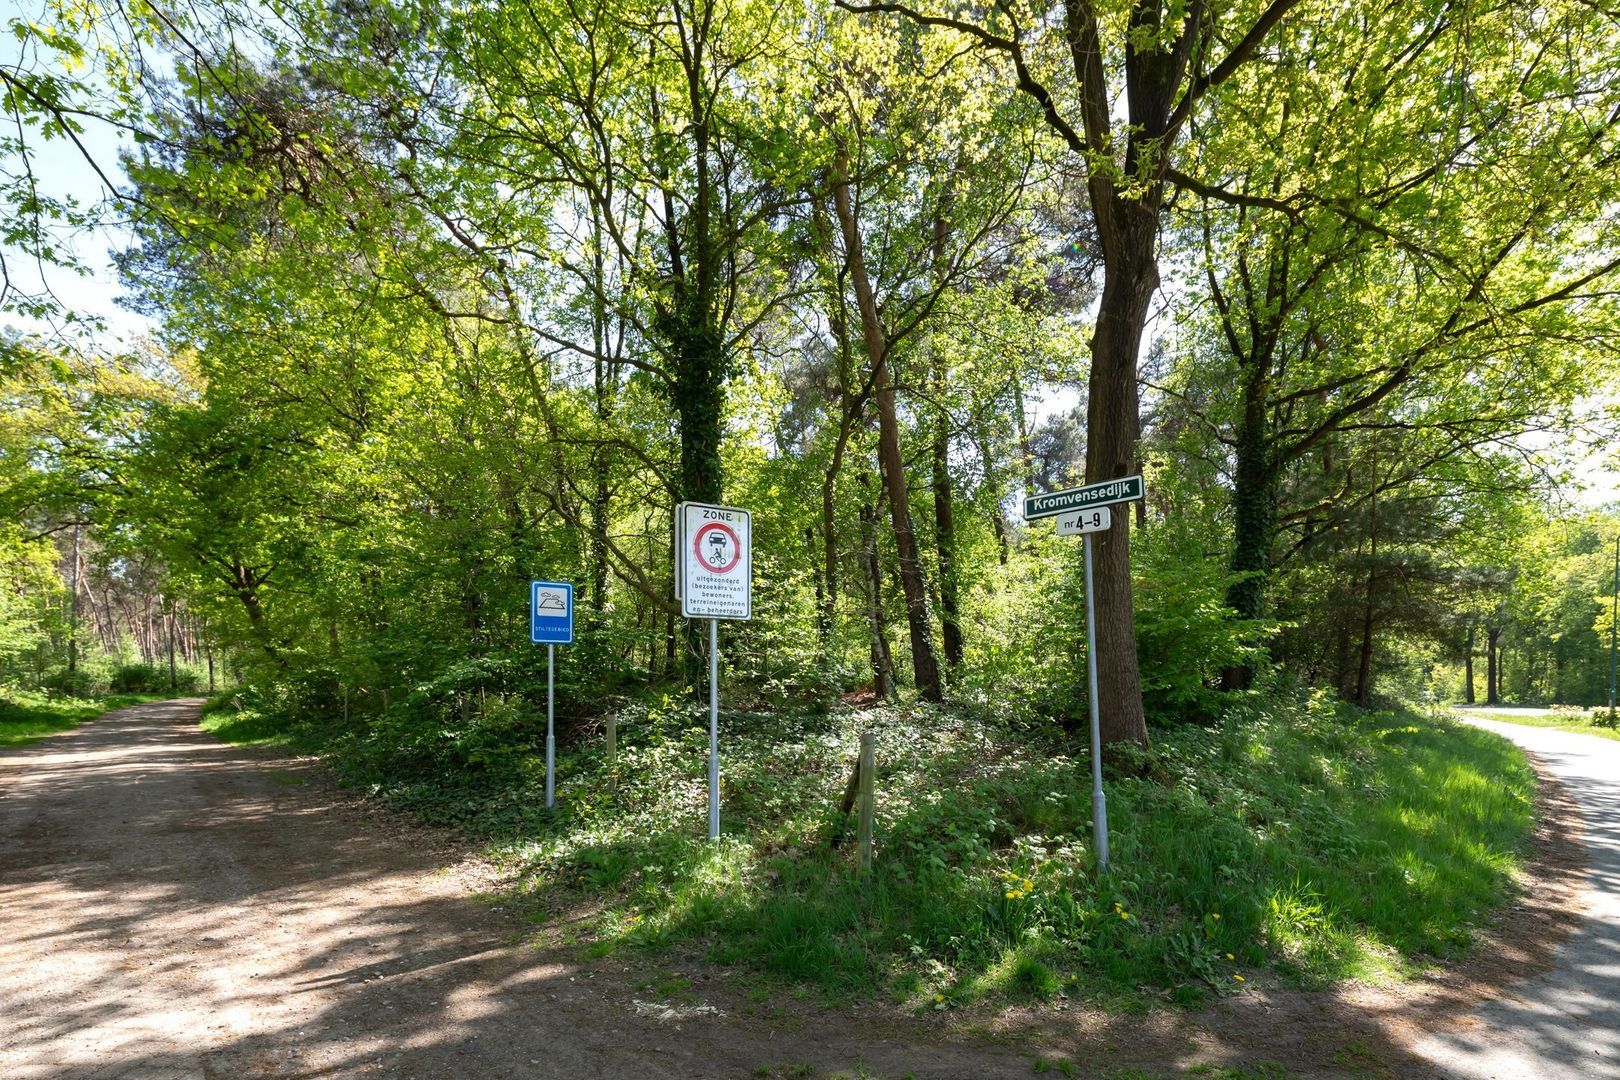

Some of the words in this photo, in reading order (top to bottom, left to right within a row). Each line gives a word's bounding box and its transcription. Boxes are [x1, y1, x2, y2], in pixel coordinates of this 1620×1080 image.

[1034, 482, 1131, 511] Kromvensedijk
[703, 510, 732, 521] ZONE
[696, 576, 740, 584] uitgezonderd
[692, 583, 728, 591] (bezoekers
[690, 598, 746, 607] terreineigenaren
